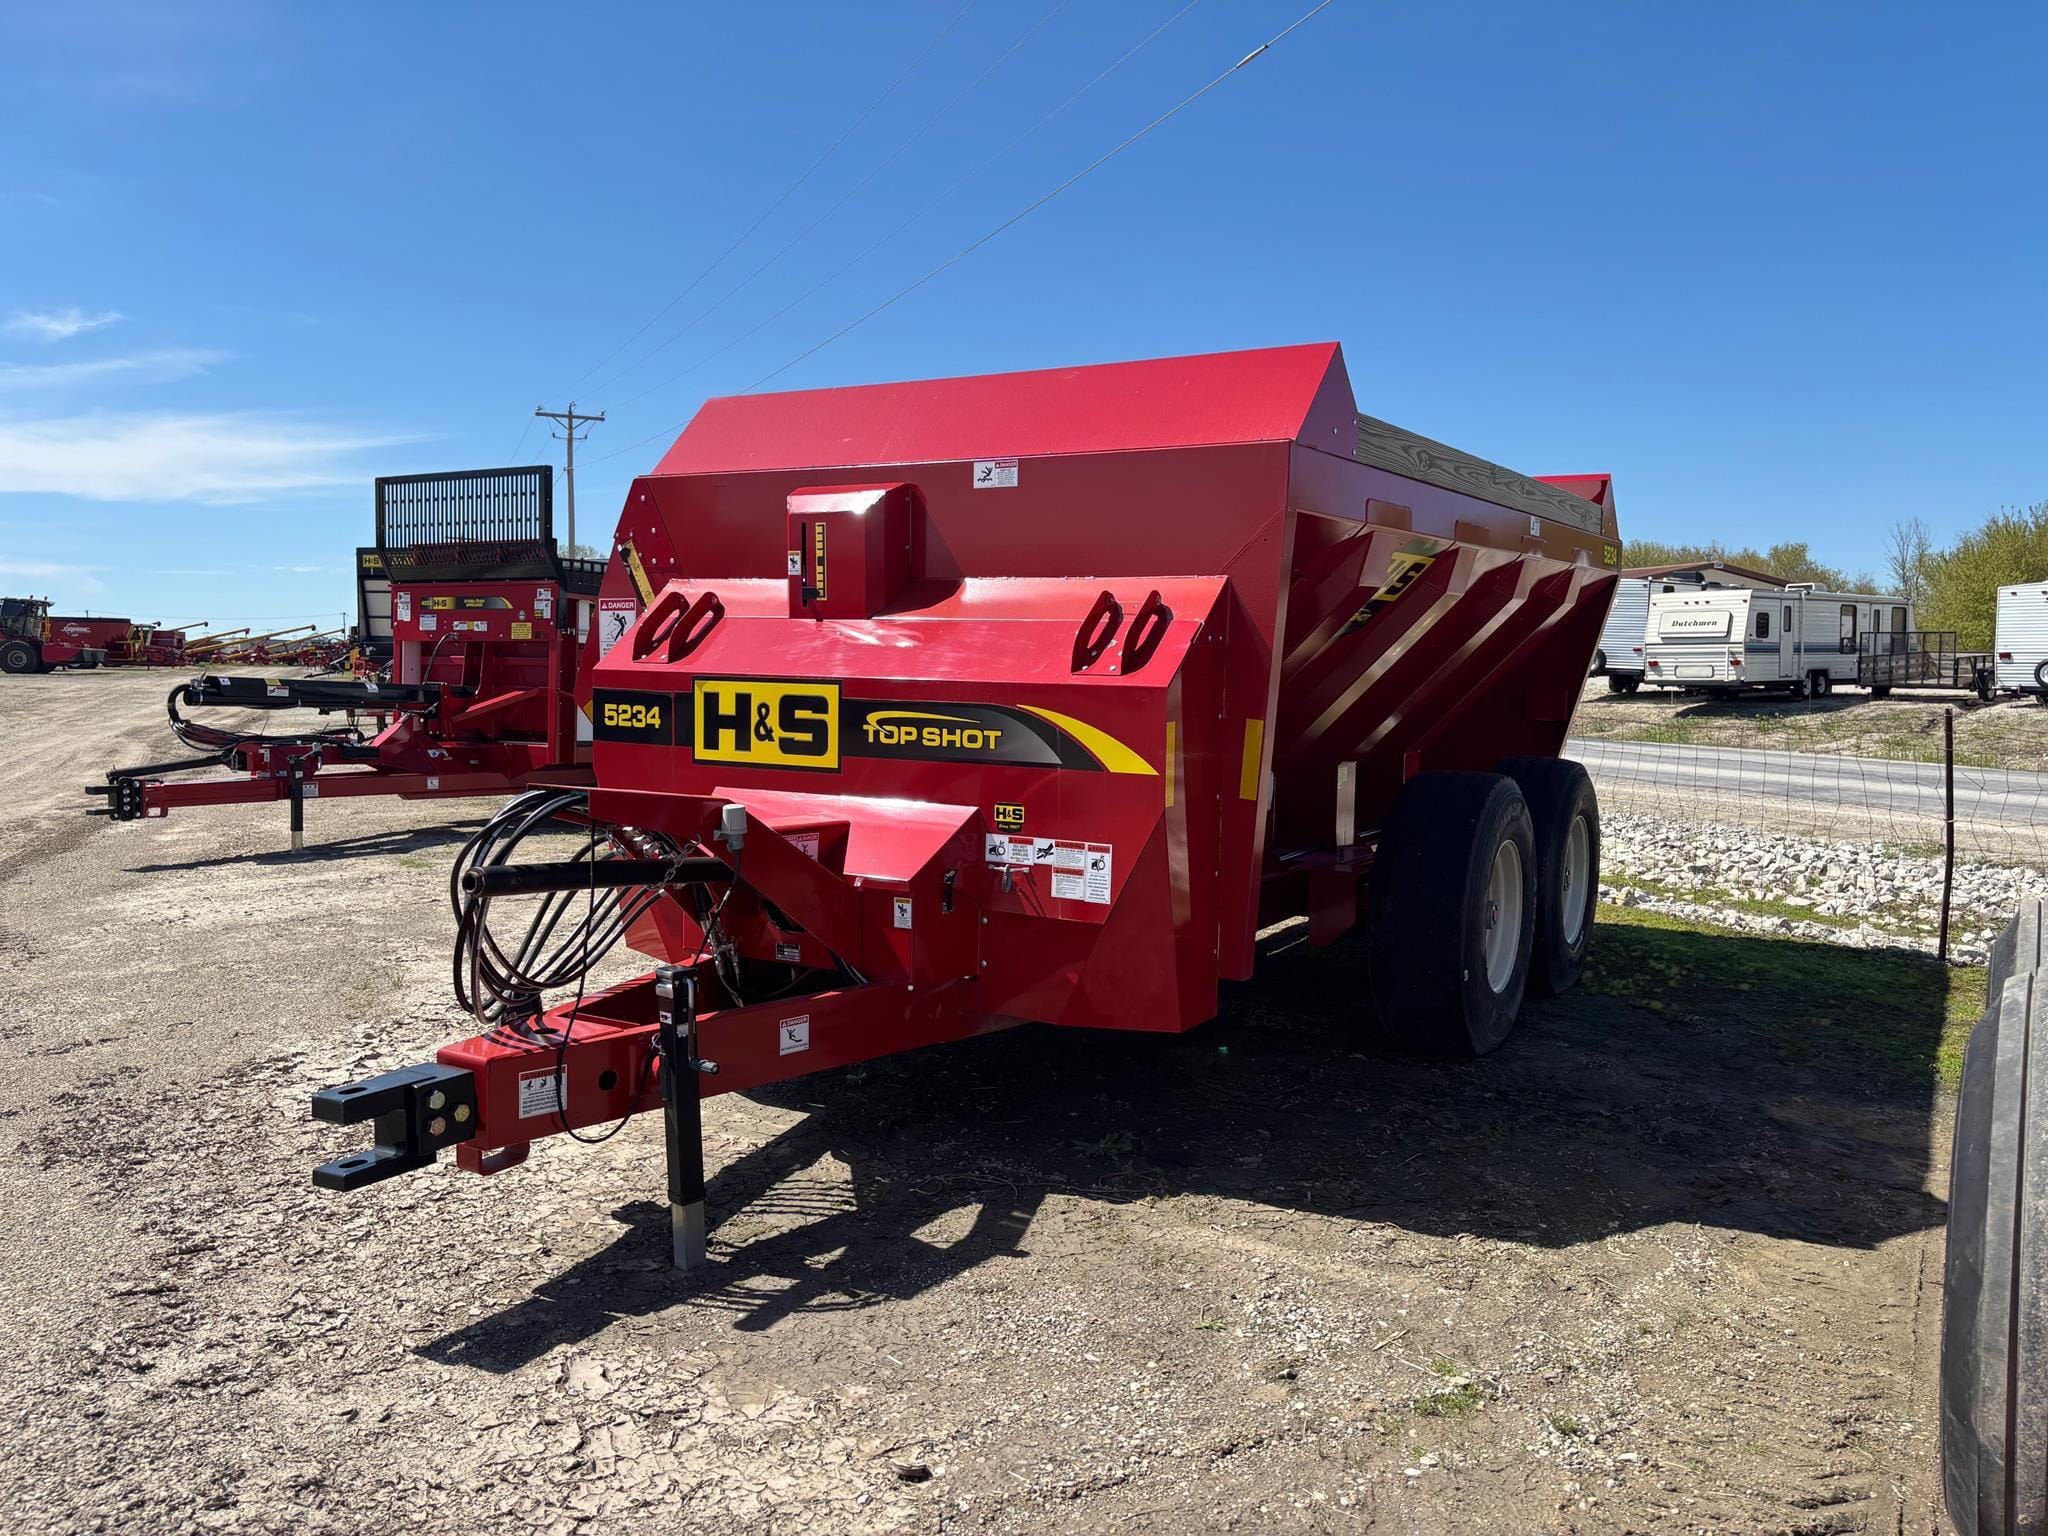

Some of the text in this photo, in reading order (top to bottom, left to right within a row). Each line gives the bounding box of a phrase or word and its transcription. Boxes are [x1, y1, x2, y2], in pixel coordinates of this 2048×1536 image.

[604, 703, 661, 729] 5234
[703, 691, 829, 757] H&S
[863, 724, 1002, 750] TOP SHOT
[995, 806, 1023, 821] H&S
[787, 1016, 808, 1025] DANGER
